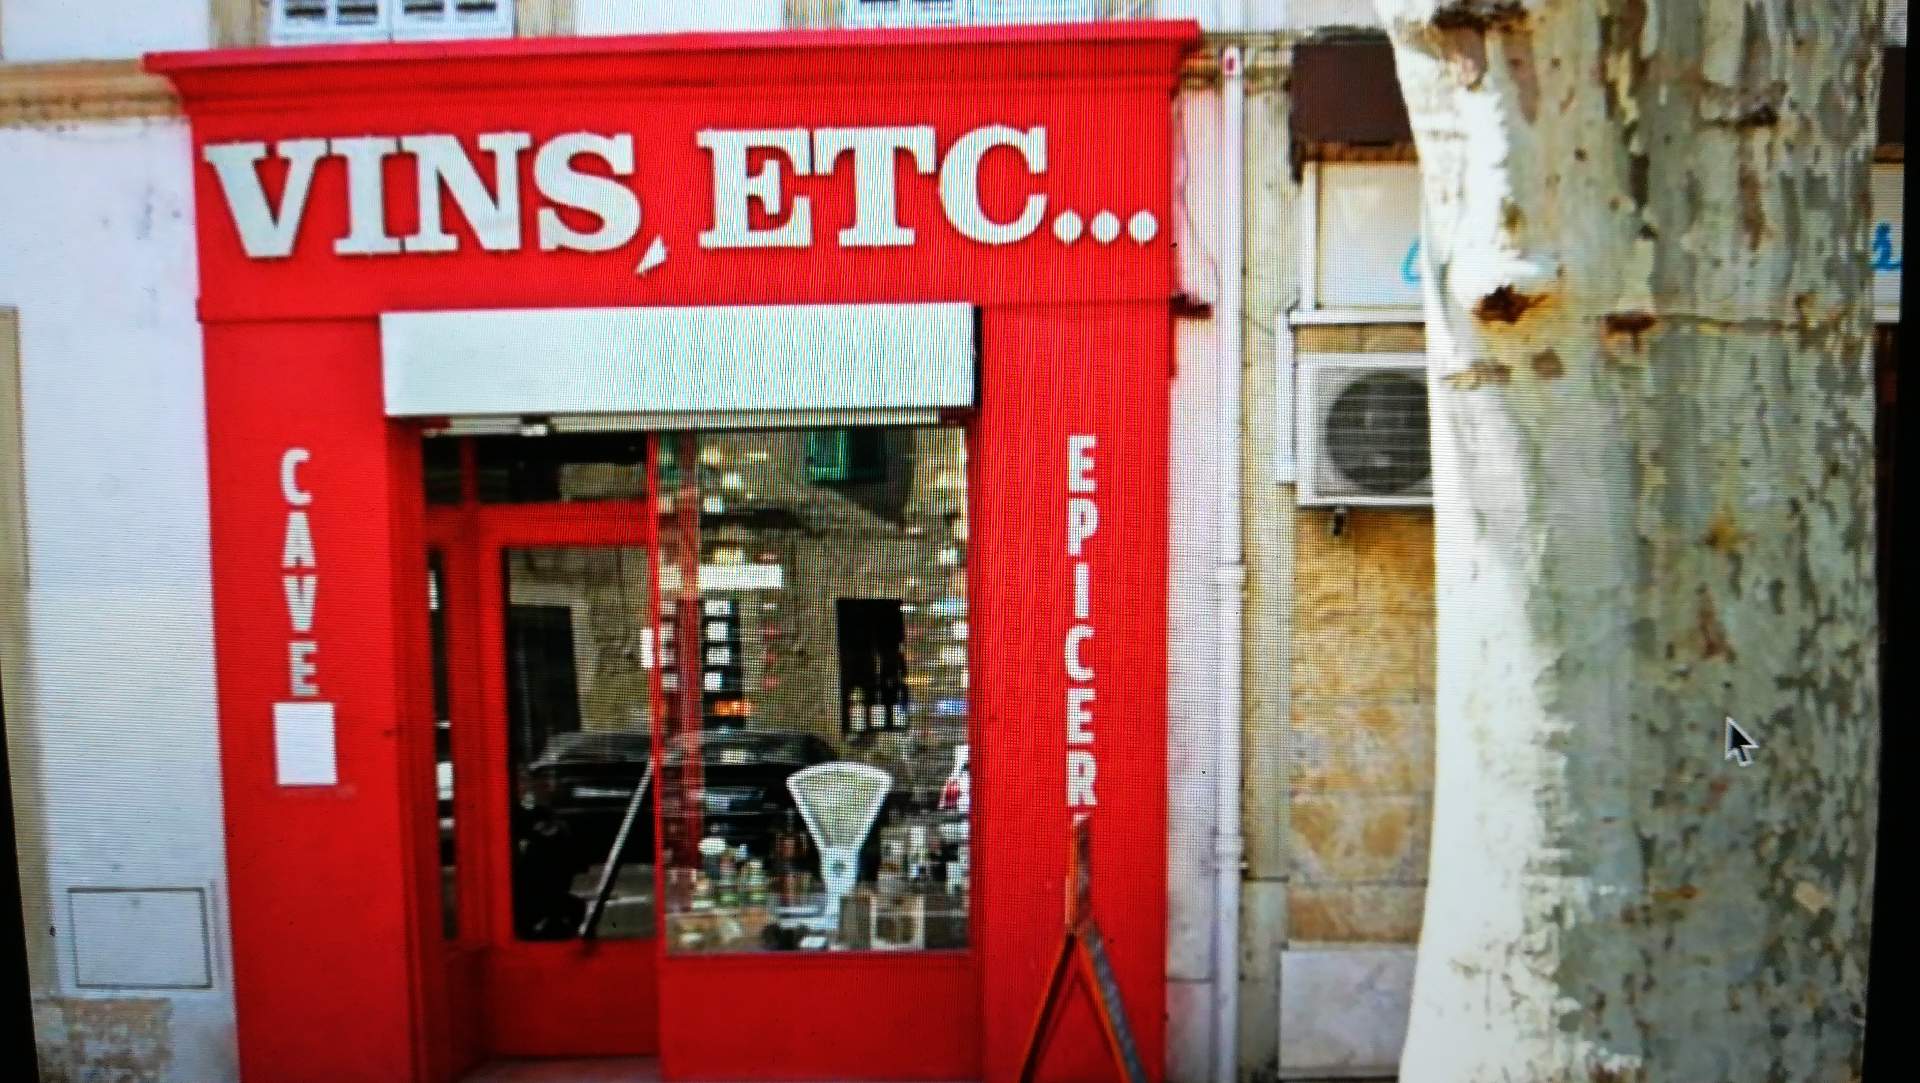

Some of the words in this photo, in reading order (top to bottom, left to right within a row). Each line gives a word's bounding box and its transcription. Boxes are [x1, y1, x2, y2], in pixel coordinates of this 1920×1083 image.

[203, 131, 667, 275] VINS,
[696, 124, 1158, 249] ETC...
[280, 447, 319, 697] CAVE
